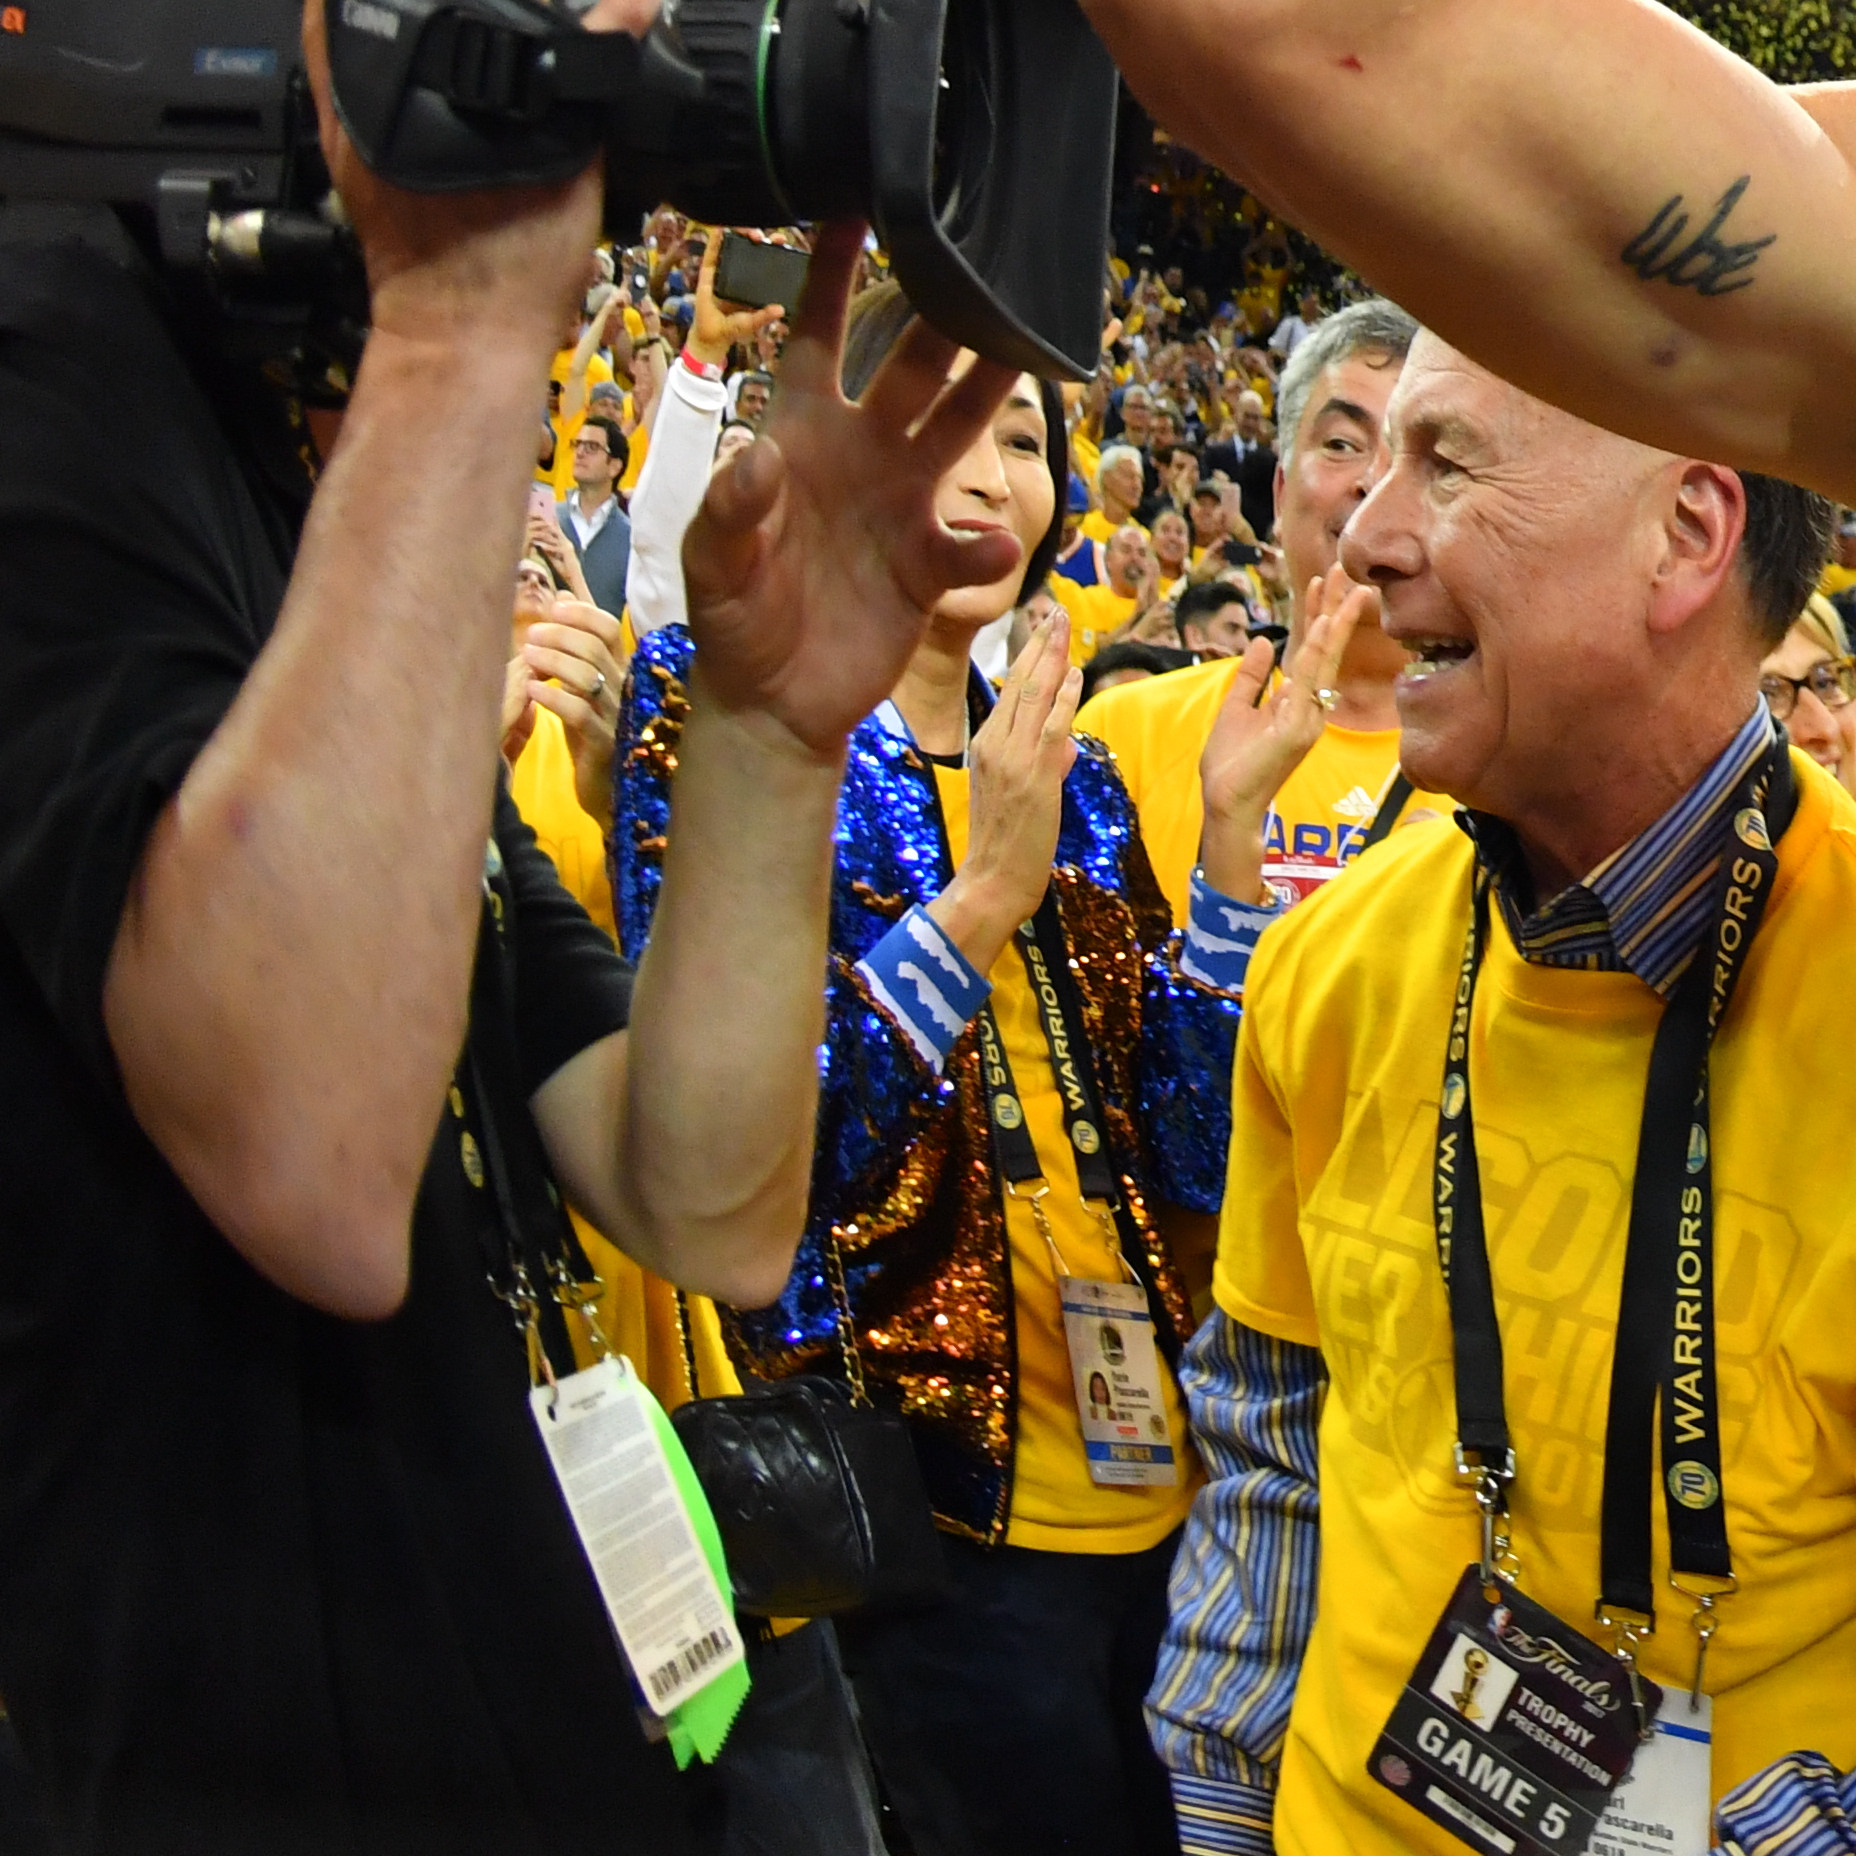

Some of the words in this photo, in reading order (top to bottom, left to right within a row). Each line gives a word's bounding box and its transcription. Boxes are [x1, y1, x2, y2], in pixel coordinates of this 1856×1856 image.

[1026, 944, 1086, 1112] WARRIORS
[1674, 1185, 1706, 1444] WARRIORS
[1681, 1472, 1706, 1496] 70
[1497, 1635, 1621, 1711] Finals
[1505, 1708, 1613, 1787] PRESENTATION
[1516, 1686, 1597, 1749] TROPHY
[1416, 1716, 1539, 1820] GAME
[1538, 1801, 1573, 1841] 5
